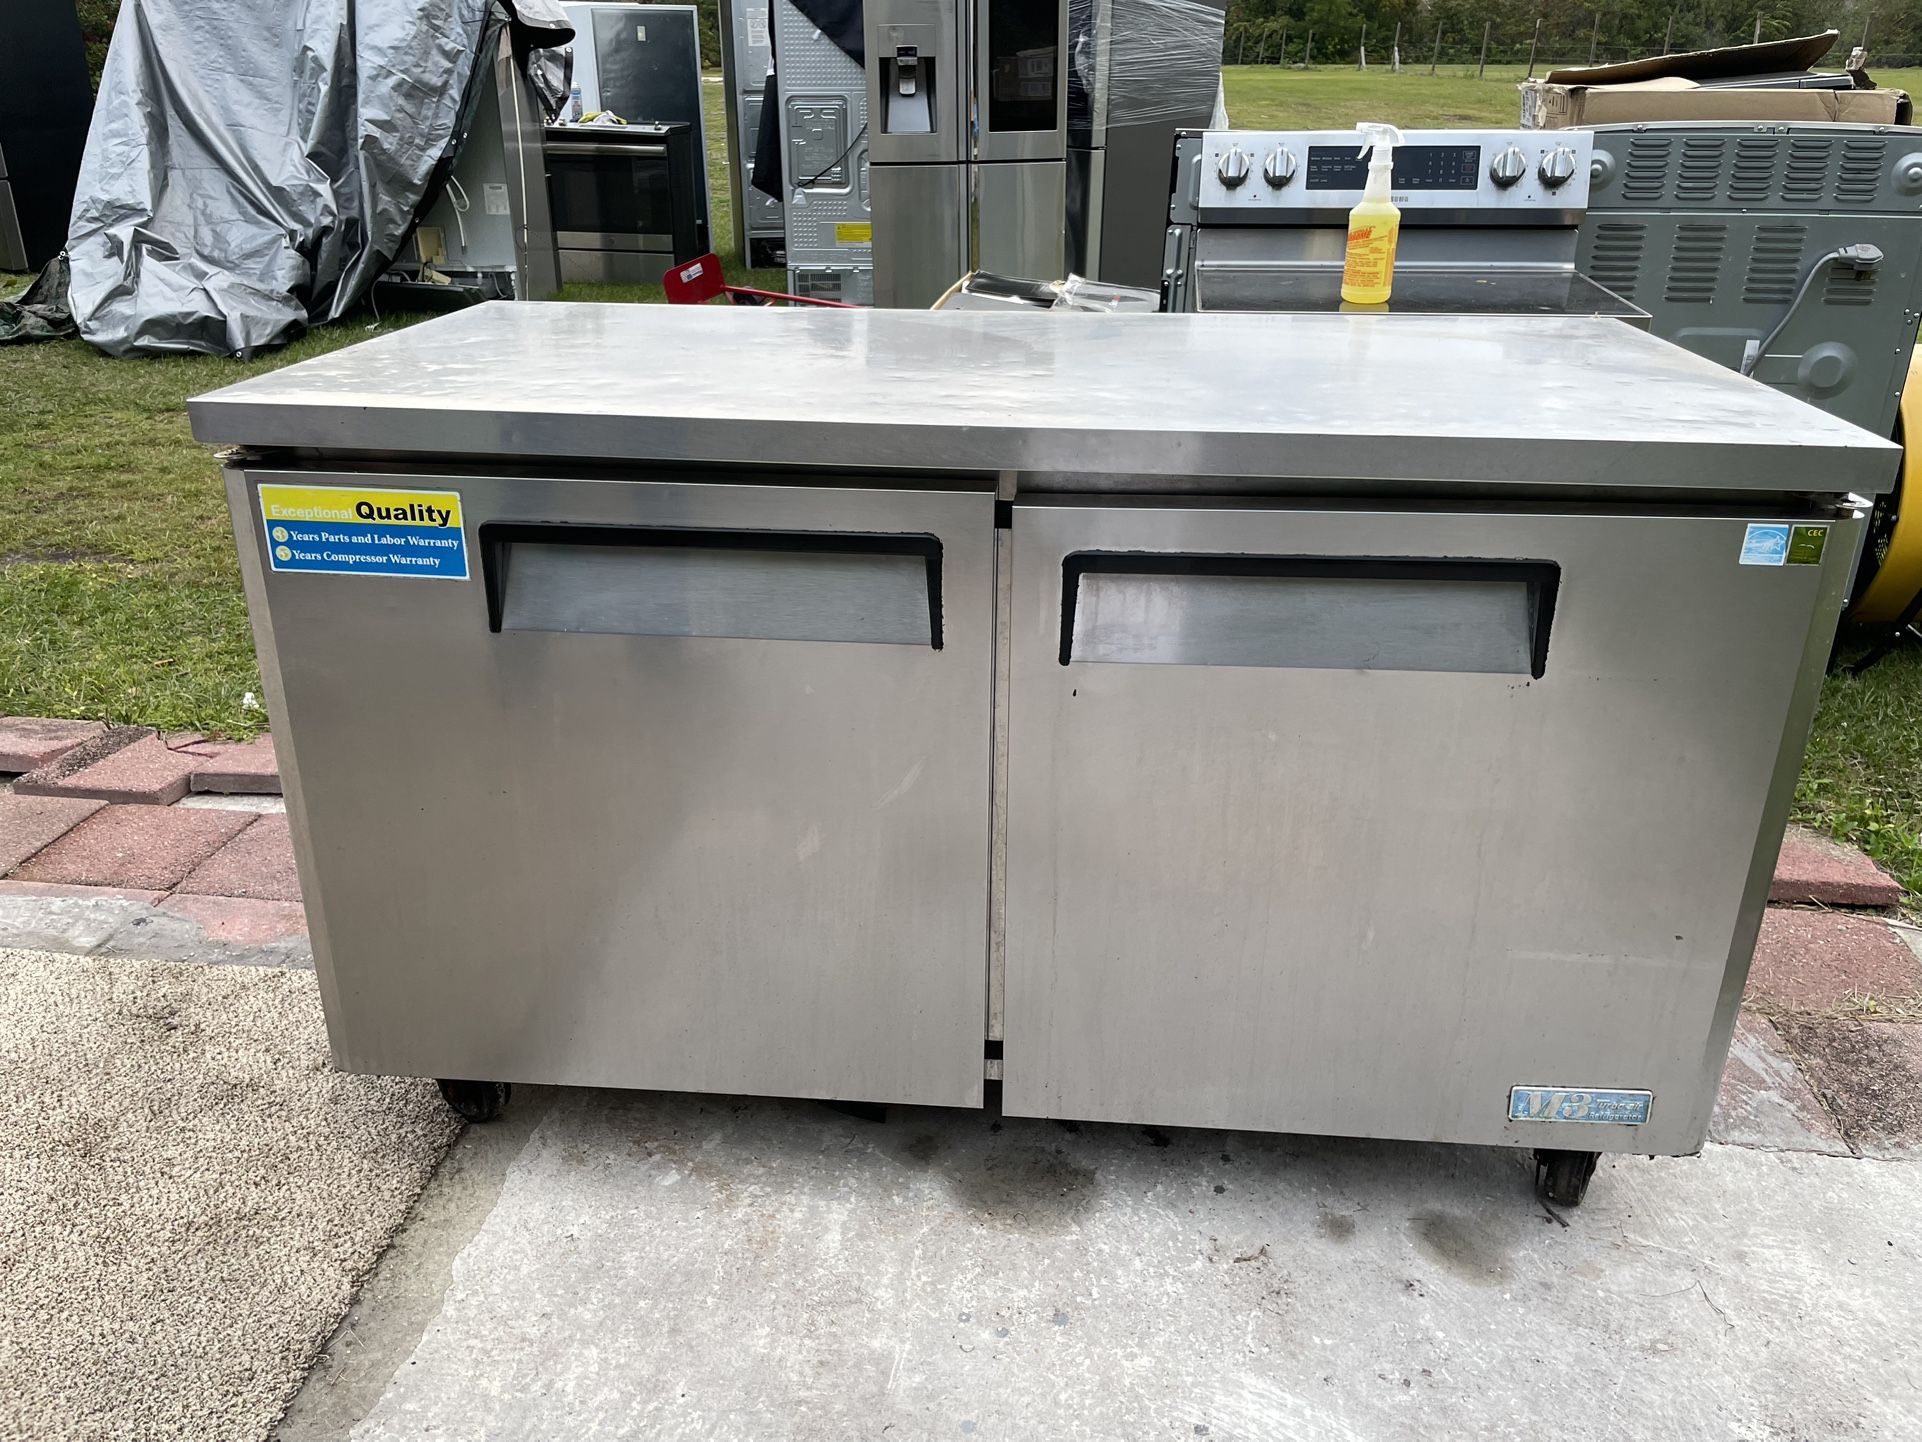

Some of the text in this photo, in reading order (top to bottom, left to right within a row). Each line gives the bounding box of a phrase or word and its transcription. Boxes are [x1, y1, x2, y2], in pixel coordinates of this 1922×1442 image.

[271, 501, 451, 527] Exceptional Quality
[290, 530, 320, 541] Years
[320, 532, 350, 543] Parts
[351, 533, 372, 544] and
[373, 534, 406, 545] Labor
[406, 535, 459, 550] Warranty
[1807, 529, 1824, 537] CEC
[292, 550, 322, 560] Years
[323, 551, 388, 564] Compressor
[388, 553, 441, 568] Warranty
